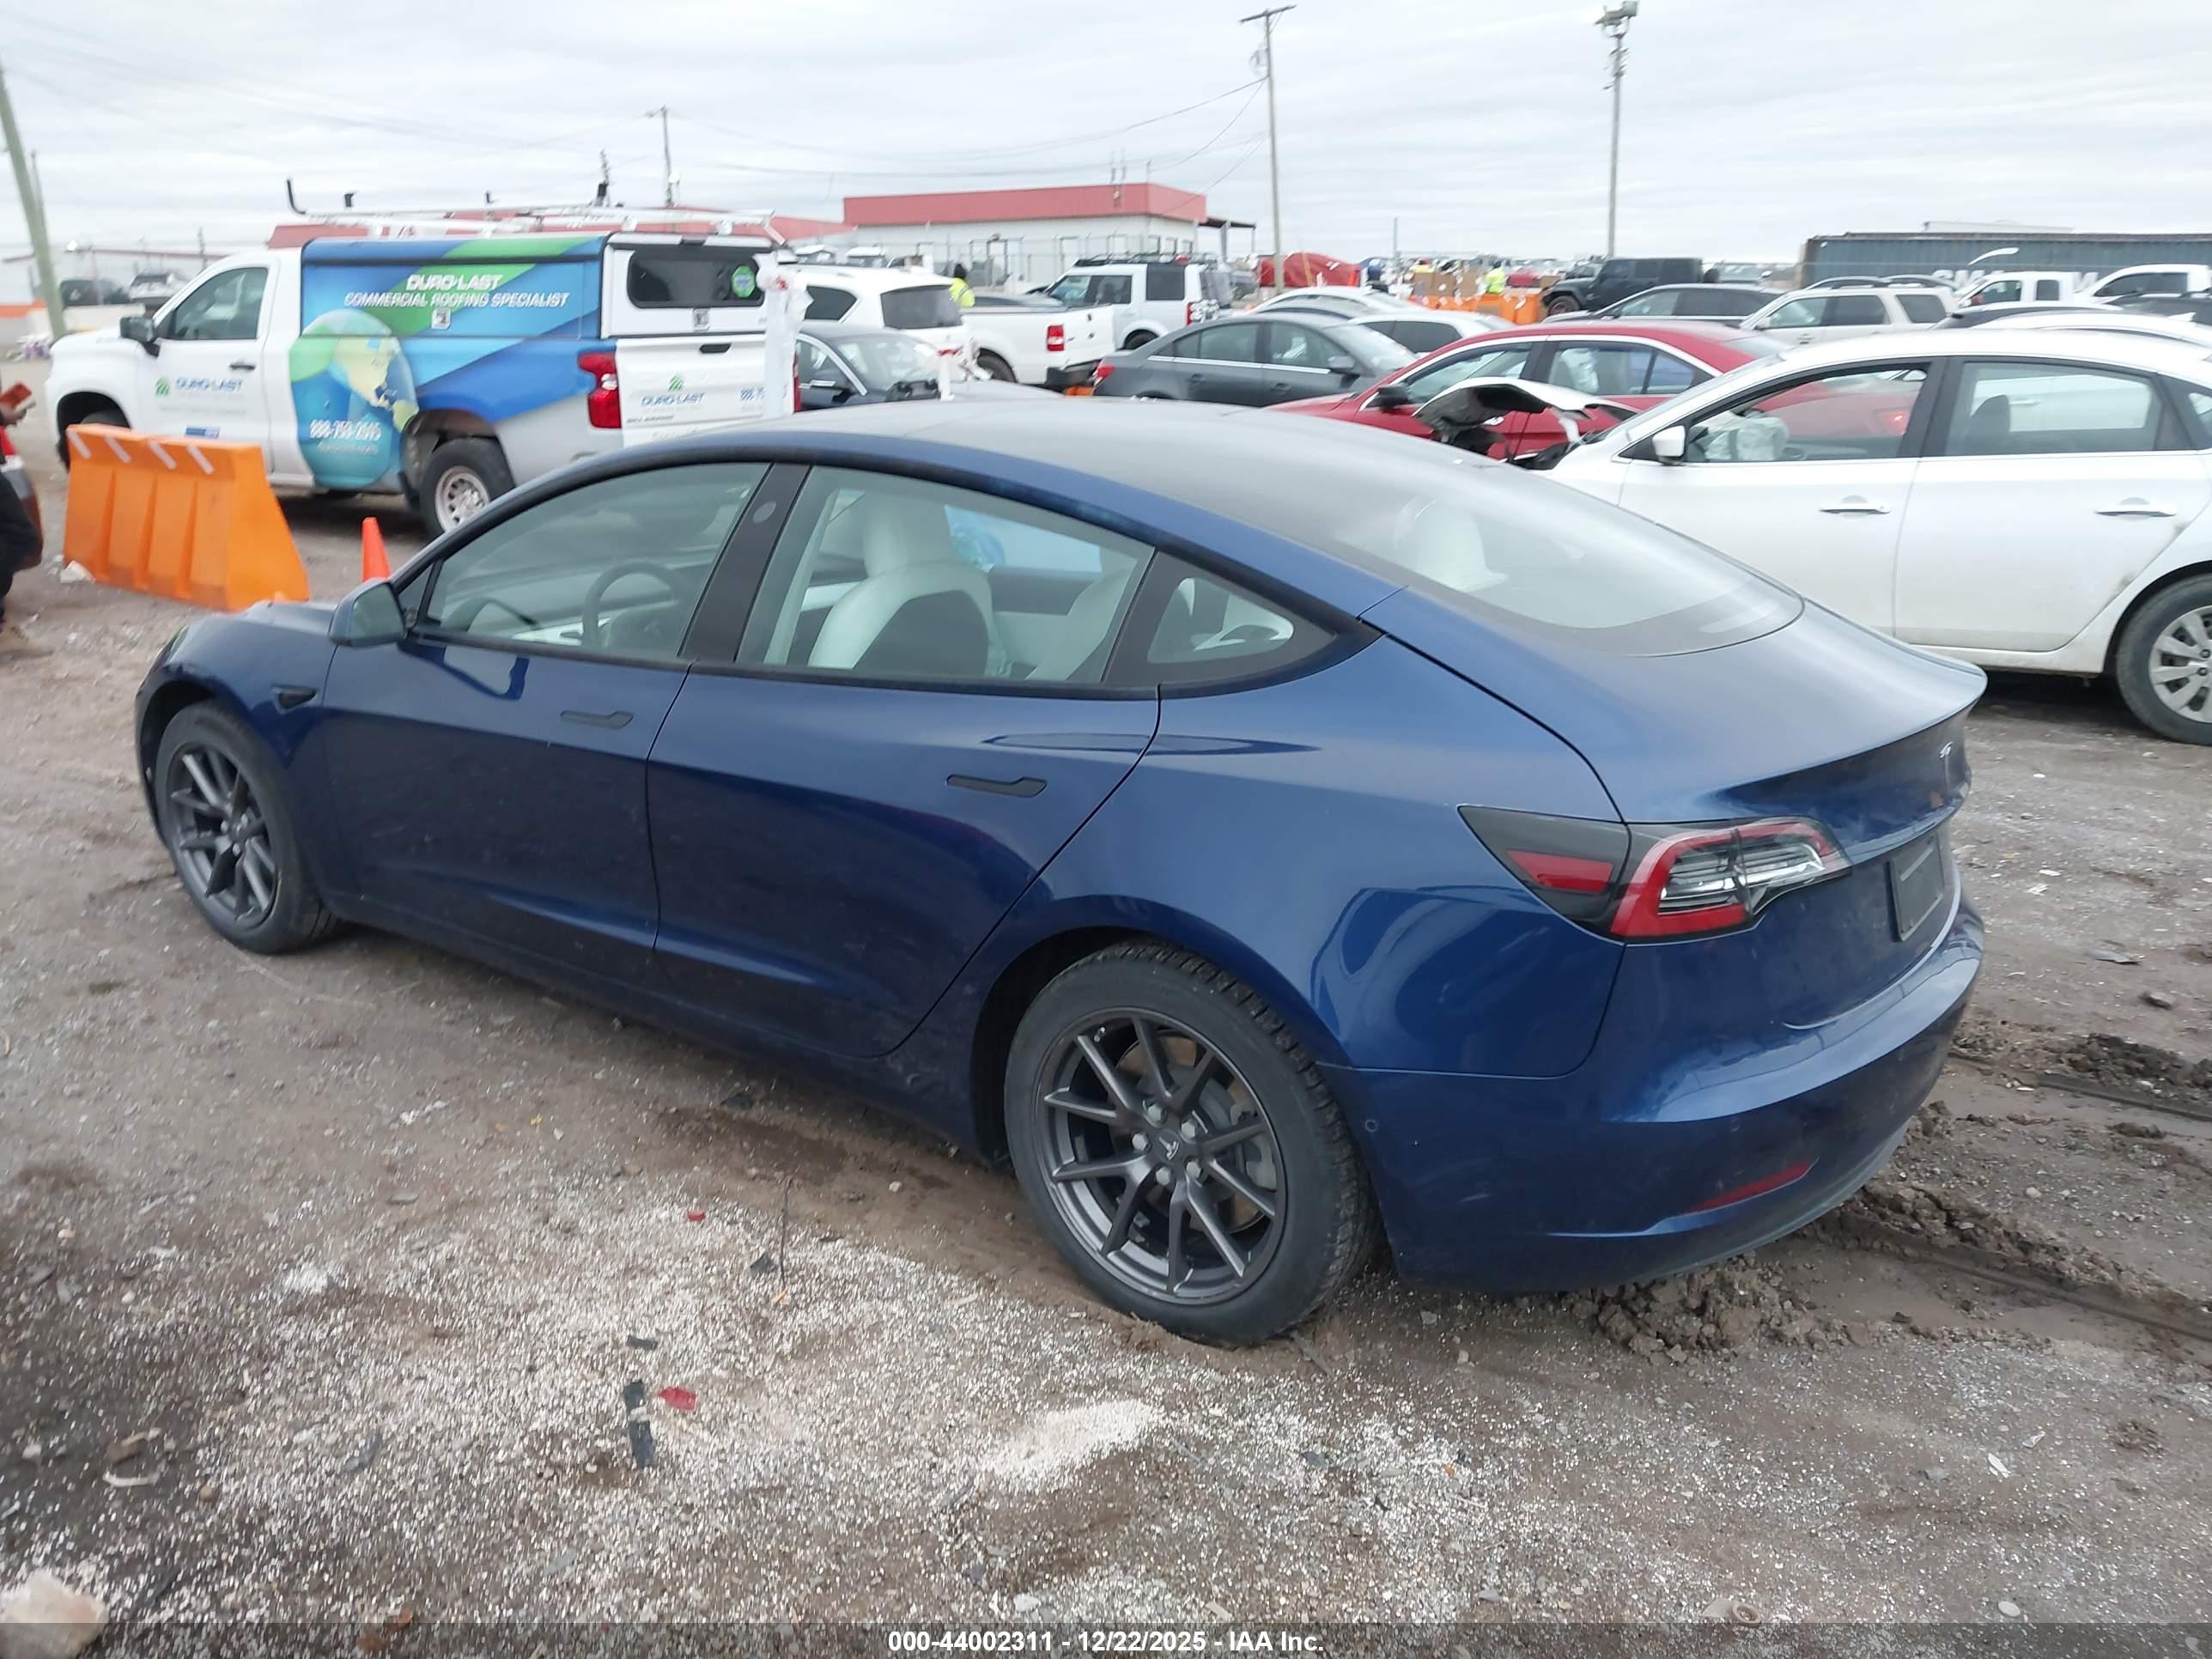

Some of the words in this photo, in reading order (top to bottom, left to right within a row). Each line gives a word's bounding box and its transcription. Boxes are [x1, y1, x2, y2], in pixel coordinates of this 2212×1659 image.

[344, 292, 428, 307] COMMERCIAL
[430, 292, 489, 308] ROOFING
[490, 292, 570, 307] SPECIALIST
